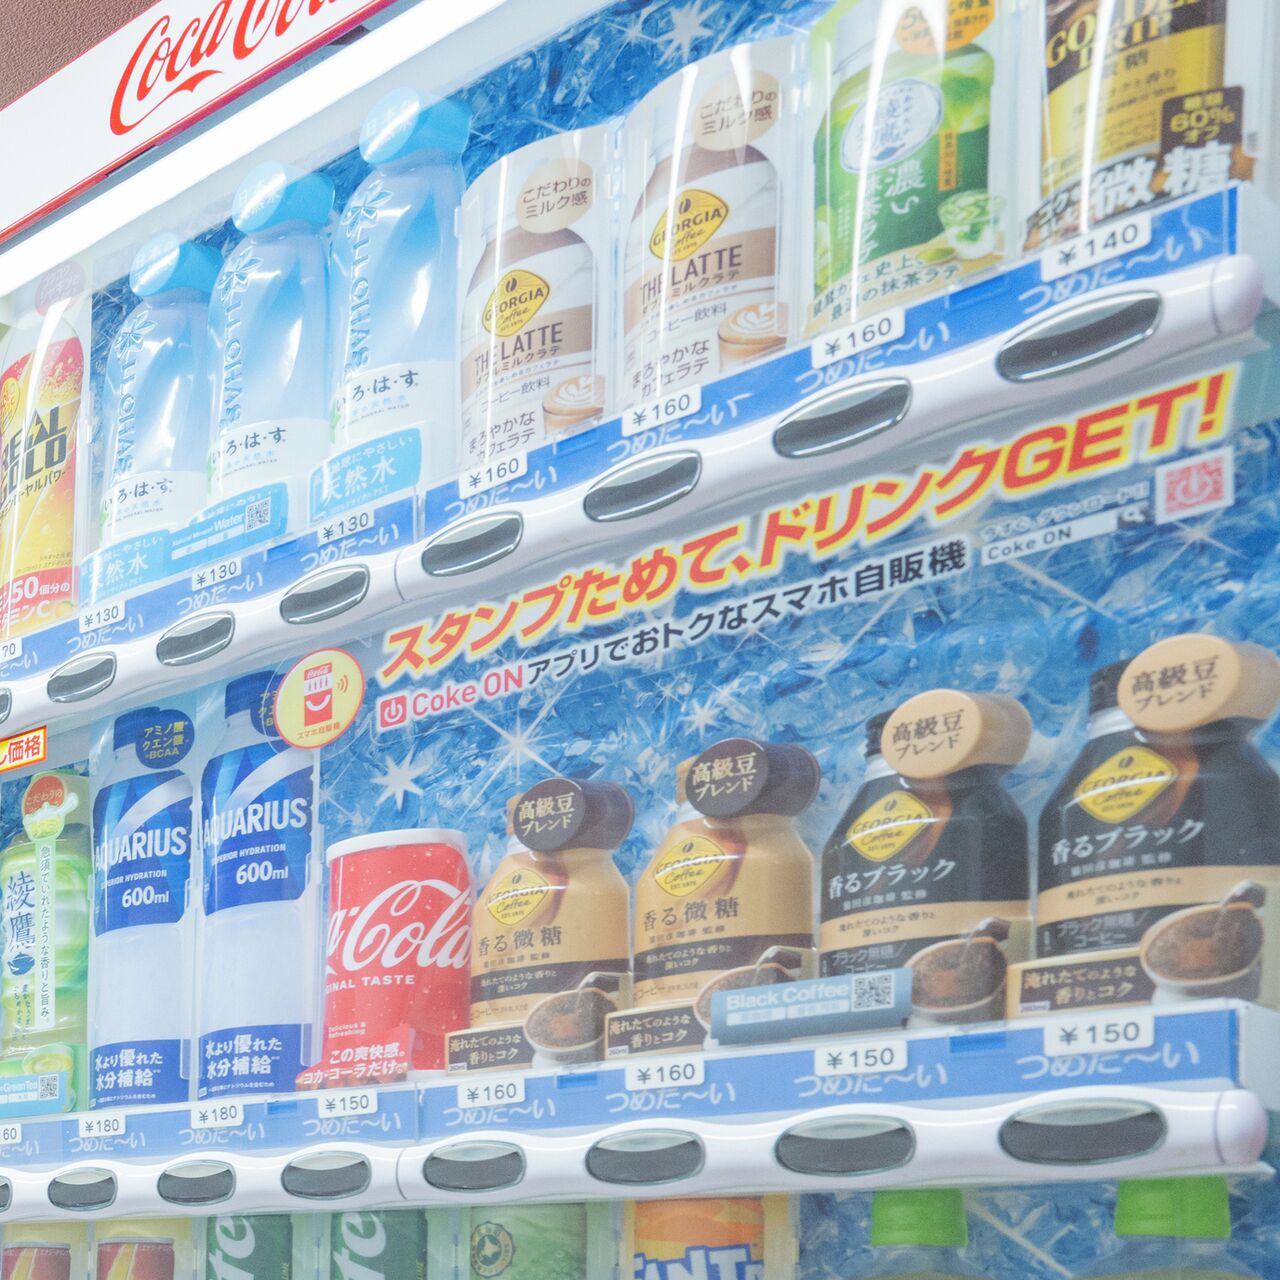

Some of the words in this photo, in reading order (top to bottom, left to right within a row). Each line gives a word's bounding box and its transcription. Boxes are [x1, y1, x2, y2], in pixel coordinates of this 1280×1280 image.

[1170, 105, 1235, 132] 60%
[522, 176, 592, 204] こだわりの
[525, 190, 589, 219] ミルク感
[1057, 223, 1140, 266] ¥140
[670, 244, 743, 286] LATTE
[475, 346, 498, 377] TH
[500, 321, 564, 362] LATTE
[824, 318, 892, 357] ¥160
[633, 393, 691, 425] ¥160
[469, 458, 520, 488] ¥160
[323, 512, 369, 540] ¥130
[988, 538, 1036, 560] Coke
[1043, 527, 1072, 545] ON
[196, 561, 237, 586] ¥130
[83, 606, 119, 627] ¥130
[410, 677, 477, 719] Coke
[476, 662, 525, 703] ON
[1132, 656, 1220, 695] 高級豆
[1138, 681, 1216, 713] ブレンド
[891, 710, 965, 743] 高級豆
[895, 732, 961, 759] ブレンド
[203, 798, 307, 848] AQUARIUS
[94, 825, 187, 872] AQUARIUS
[236, 860, 288, 884] 600ml
[7, 871, 35, 952] 綾鷹
[121, 885, 170, 908] 600ml
[361, 975, 415, 986] TASTE
[725, 986, 779, 1010] Black
[781, 979, 849, 1004] Coffee
[329, 1043, 405, 1064] この爽快感。
